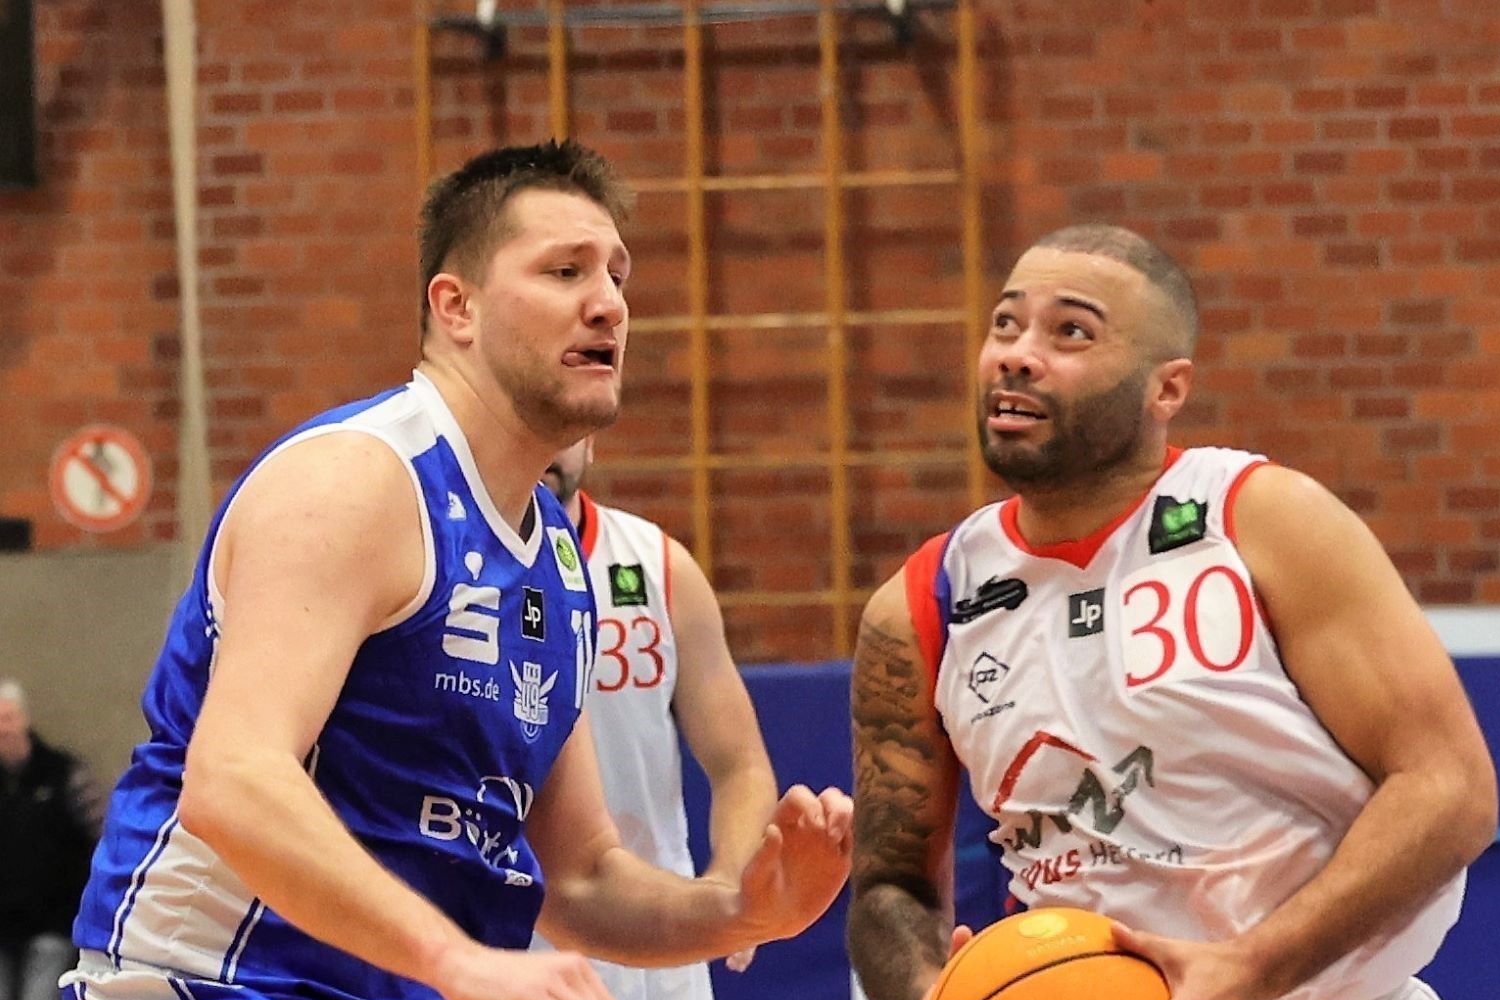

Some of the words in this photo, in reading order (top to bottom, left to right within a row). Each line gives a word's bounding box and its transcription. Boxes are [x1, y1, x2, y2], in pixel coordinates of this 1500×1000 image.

[596, 616, 665, 693] 33
[1123, 565, 1255, 689] 30
[435, 670, 500, 701] mbs.de
